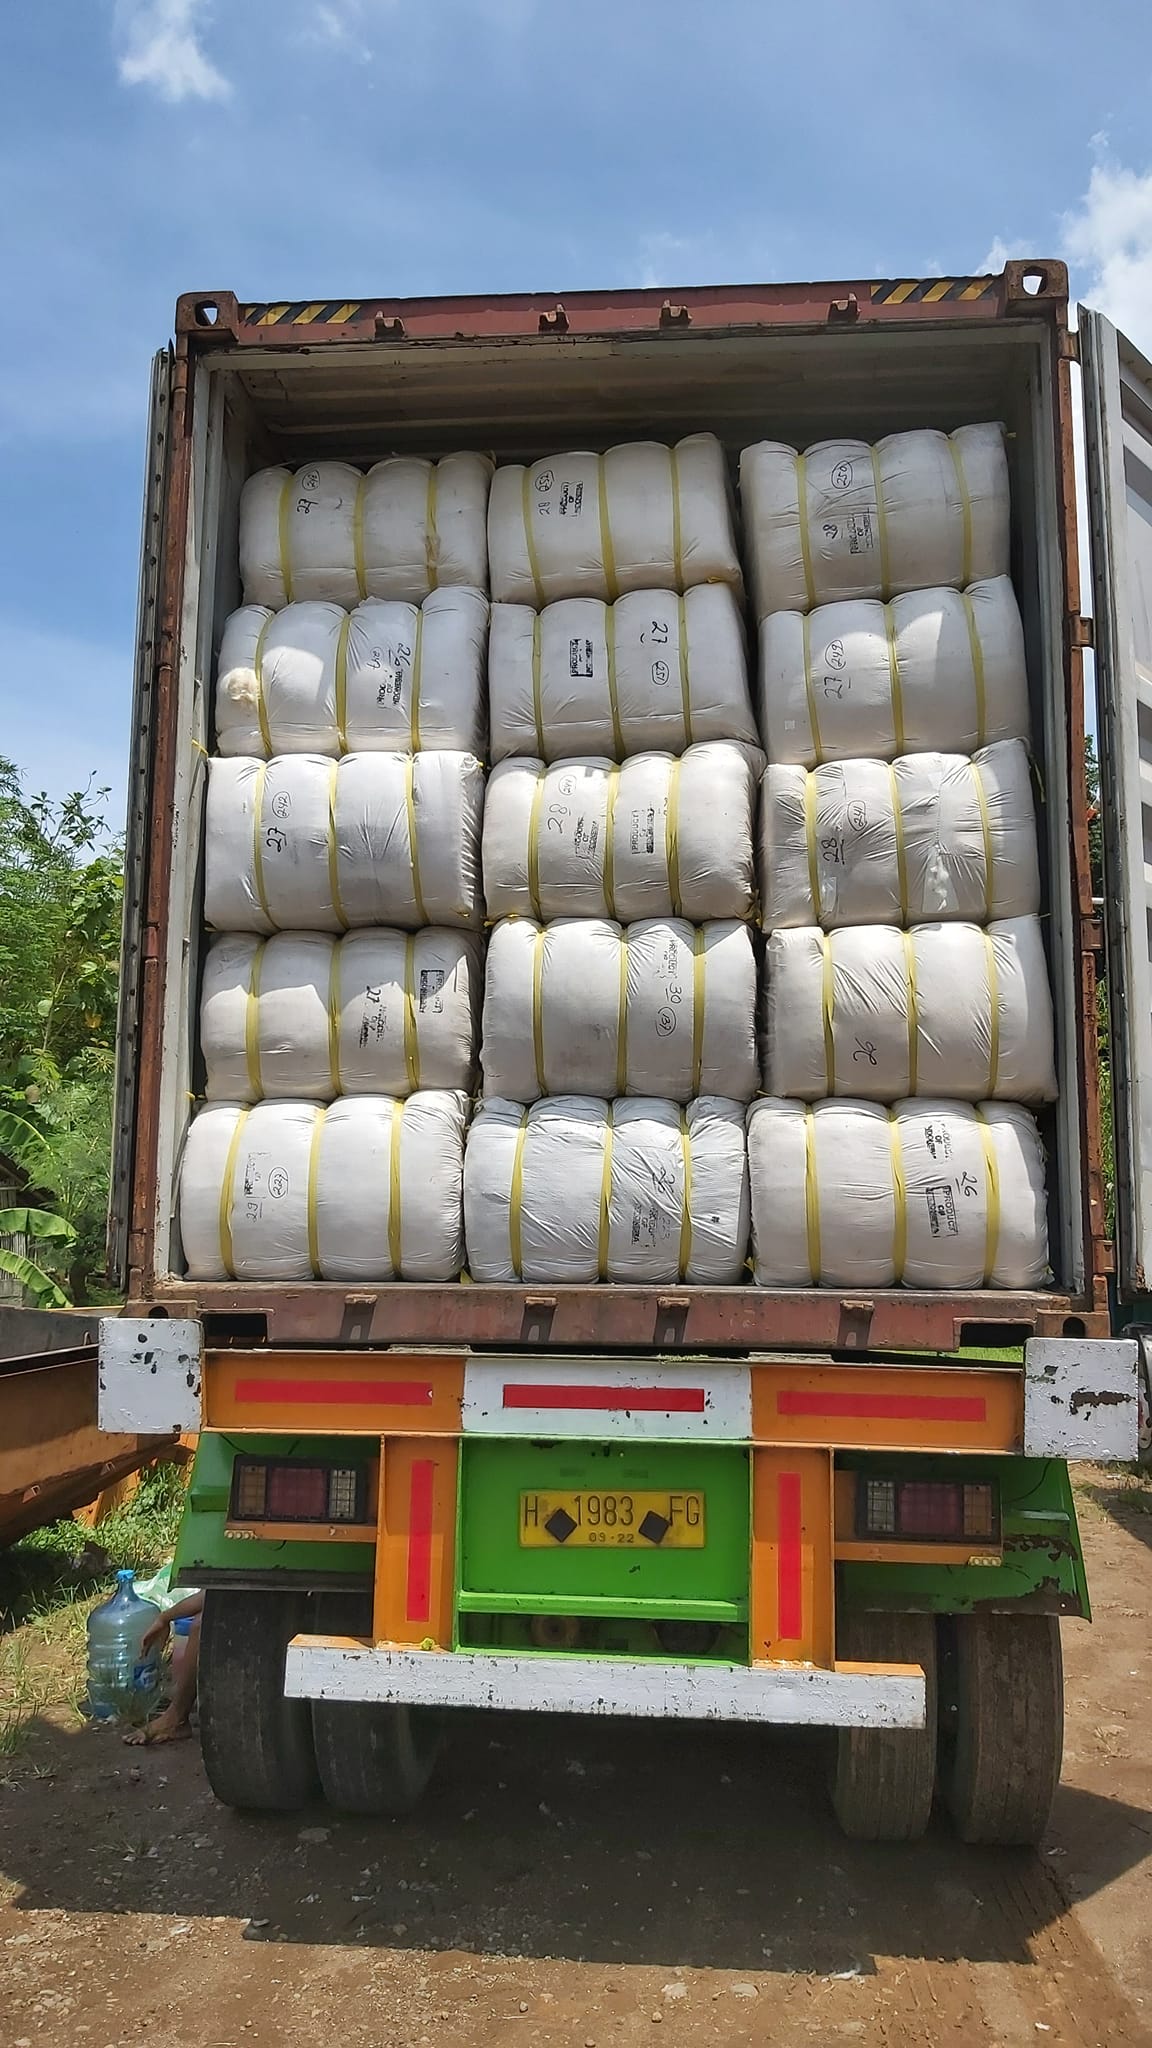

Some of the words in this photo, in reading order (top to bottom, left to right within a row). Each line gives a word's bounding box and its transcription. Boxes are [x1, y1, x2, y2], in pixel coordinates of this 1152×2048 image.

[836, 464, 848, 486] 250
[296, 498, 319, 514] 27
[822, 523, 839, 539] 28
[650, 620, 669, 644] 27
[394, 642, 411, 667] 26
[831, 643, 843, 668] 249
[823, 676, 843, 699] 27
[276, 796, 289, 817] 242
[853, 805, 865, 828] 241
[547, 803, 568, 835] 28
[265, 826, 288, 853] 27
[821, 837, 840, 863] 28
[366, 985, 382, 1004] 27
[669, 982, 682, 1004] 30
[852, 1036, 878, 1066] 26
[934, 1134, 943, 1145] OF
[960, 1171, 978, 1198] 26
[245, 1201, 259, 1223] 29
[943, 1187, 957, 1233] PRODUCT
[524, 1495, 539, 1527] H
[573, 1495, 634, 1527] 1983
[668, 1495, 700, 1527] FG
